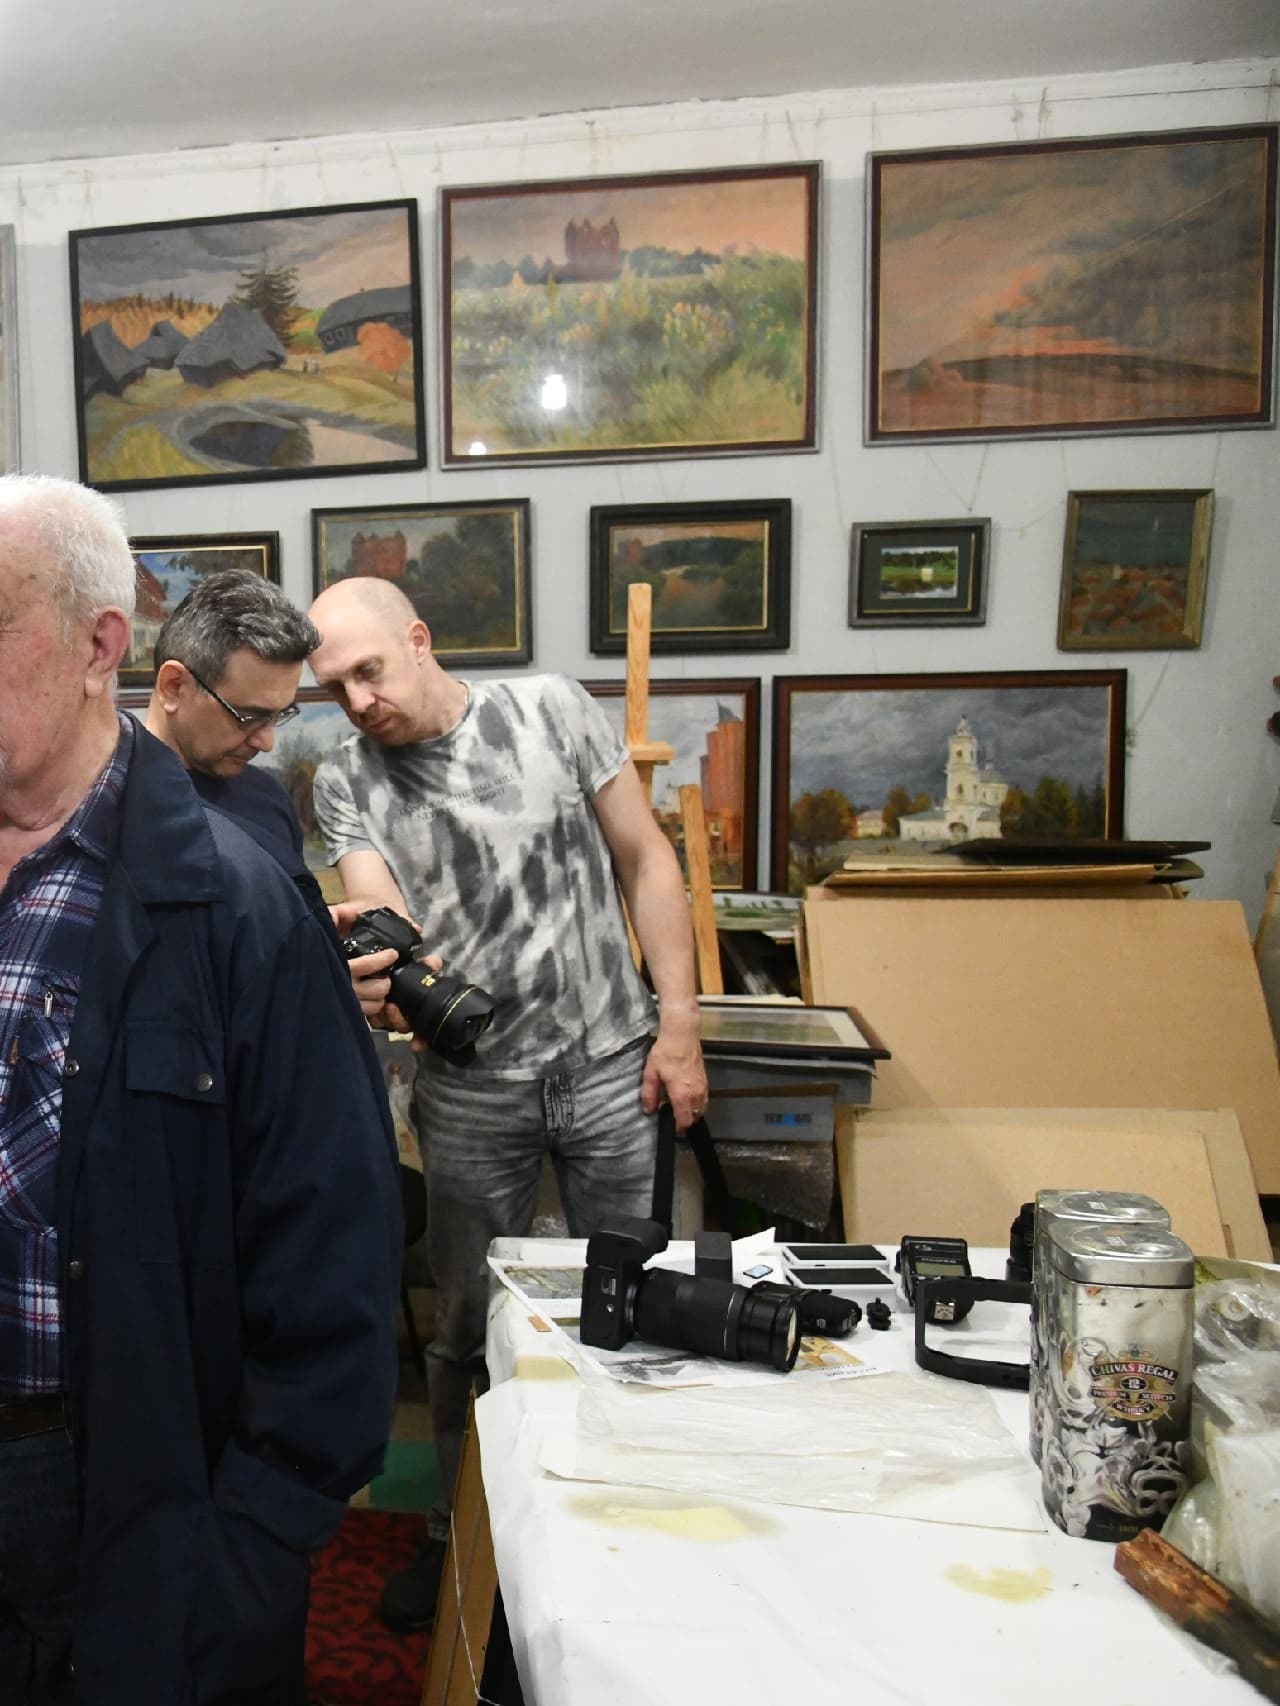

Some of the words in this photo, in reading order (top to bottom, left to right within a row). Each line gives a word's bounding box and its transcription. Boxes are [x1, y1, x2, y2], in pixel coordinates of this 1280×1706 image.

[1090, 1362, 1135, 1376] CHIVAS
[1137, 1363, 1175, 1381] REGAL
[1128, 1378, 1140, 1389] 12
